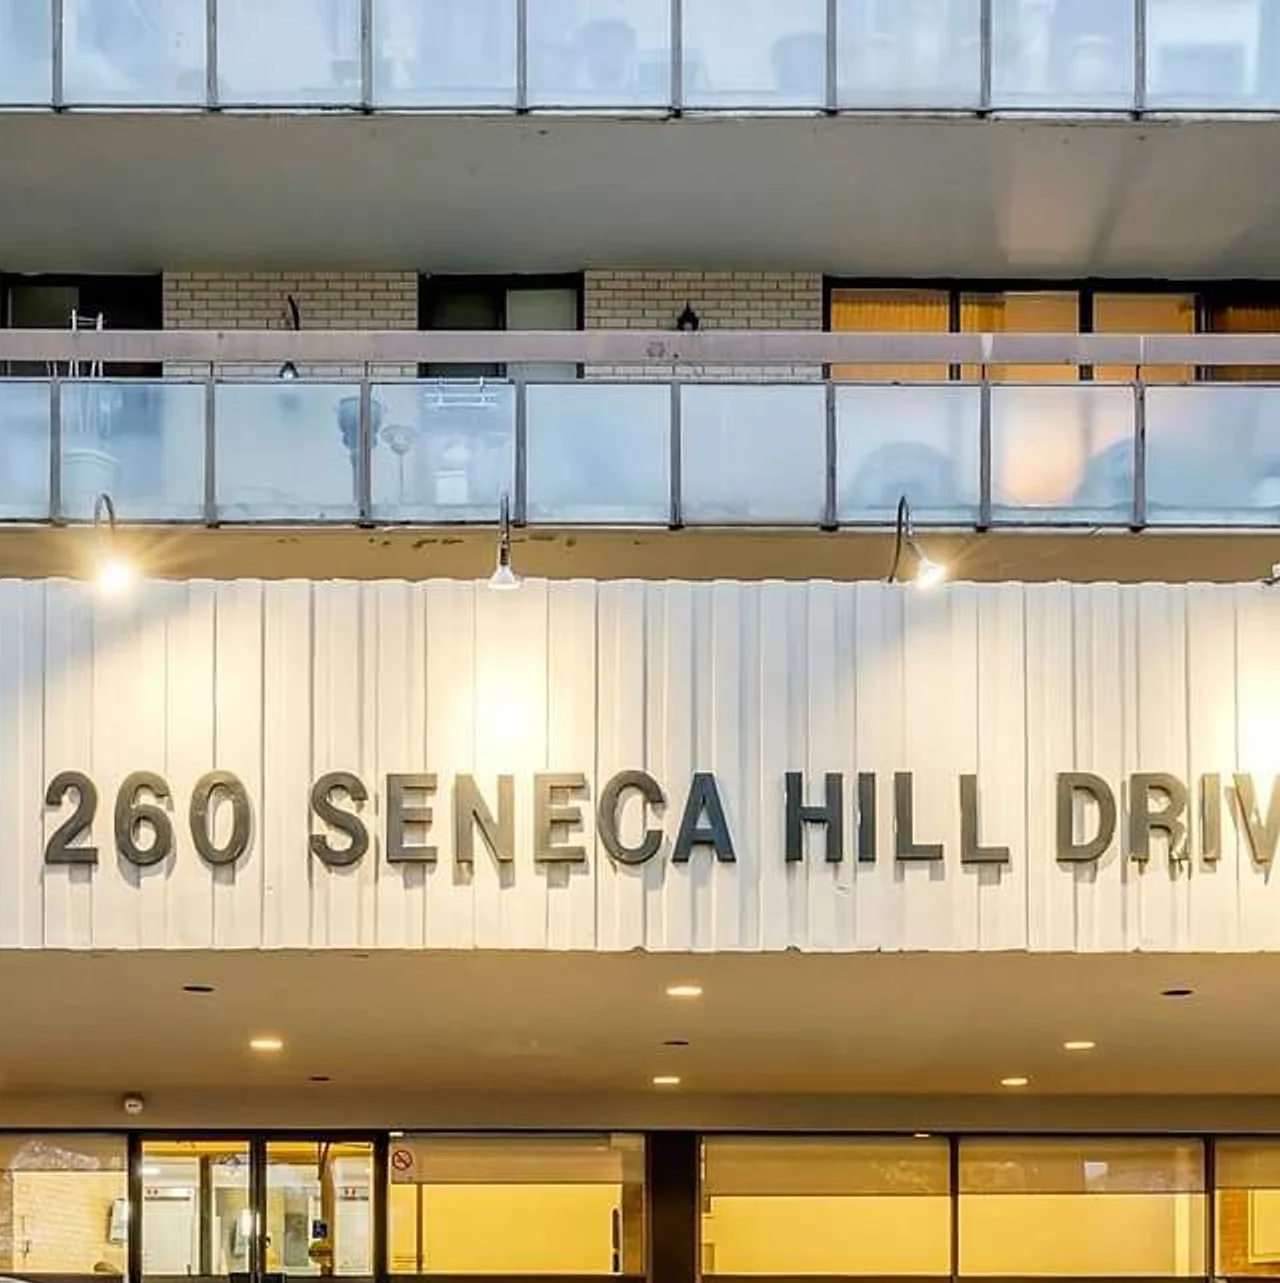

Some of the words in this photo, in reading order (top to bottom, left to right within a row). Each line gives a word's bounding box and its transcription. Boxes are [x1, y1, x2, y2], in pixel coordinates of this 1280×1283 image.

[45, 770, 255, 866] 260
[310, 770, 738, 866] SENECA
[783, 771, 1011, 864] HILL
